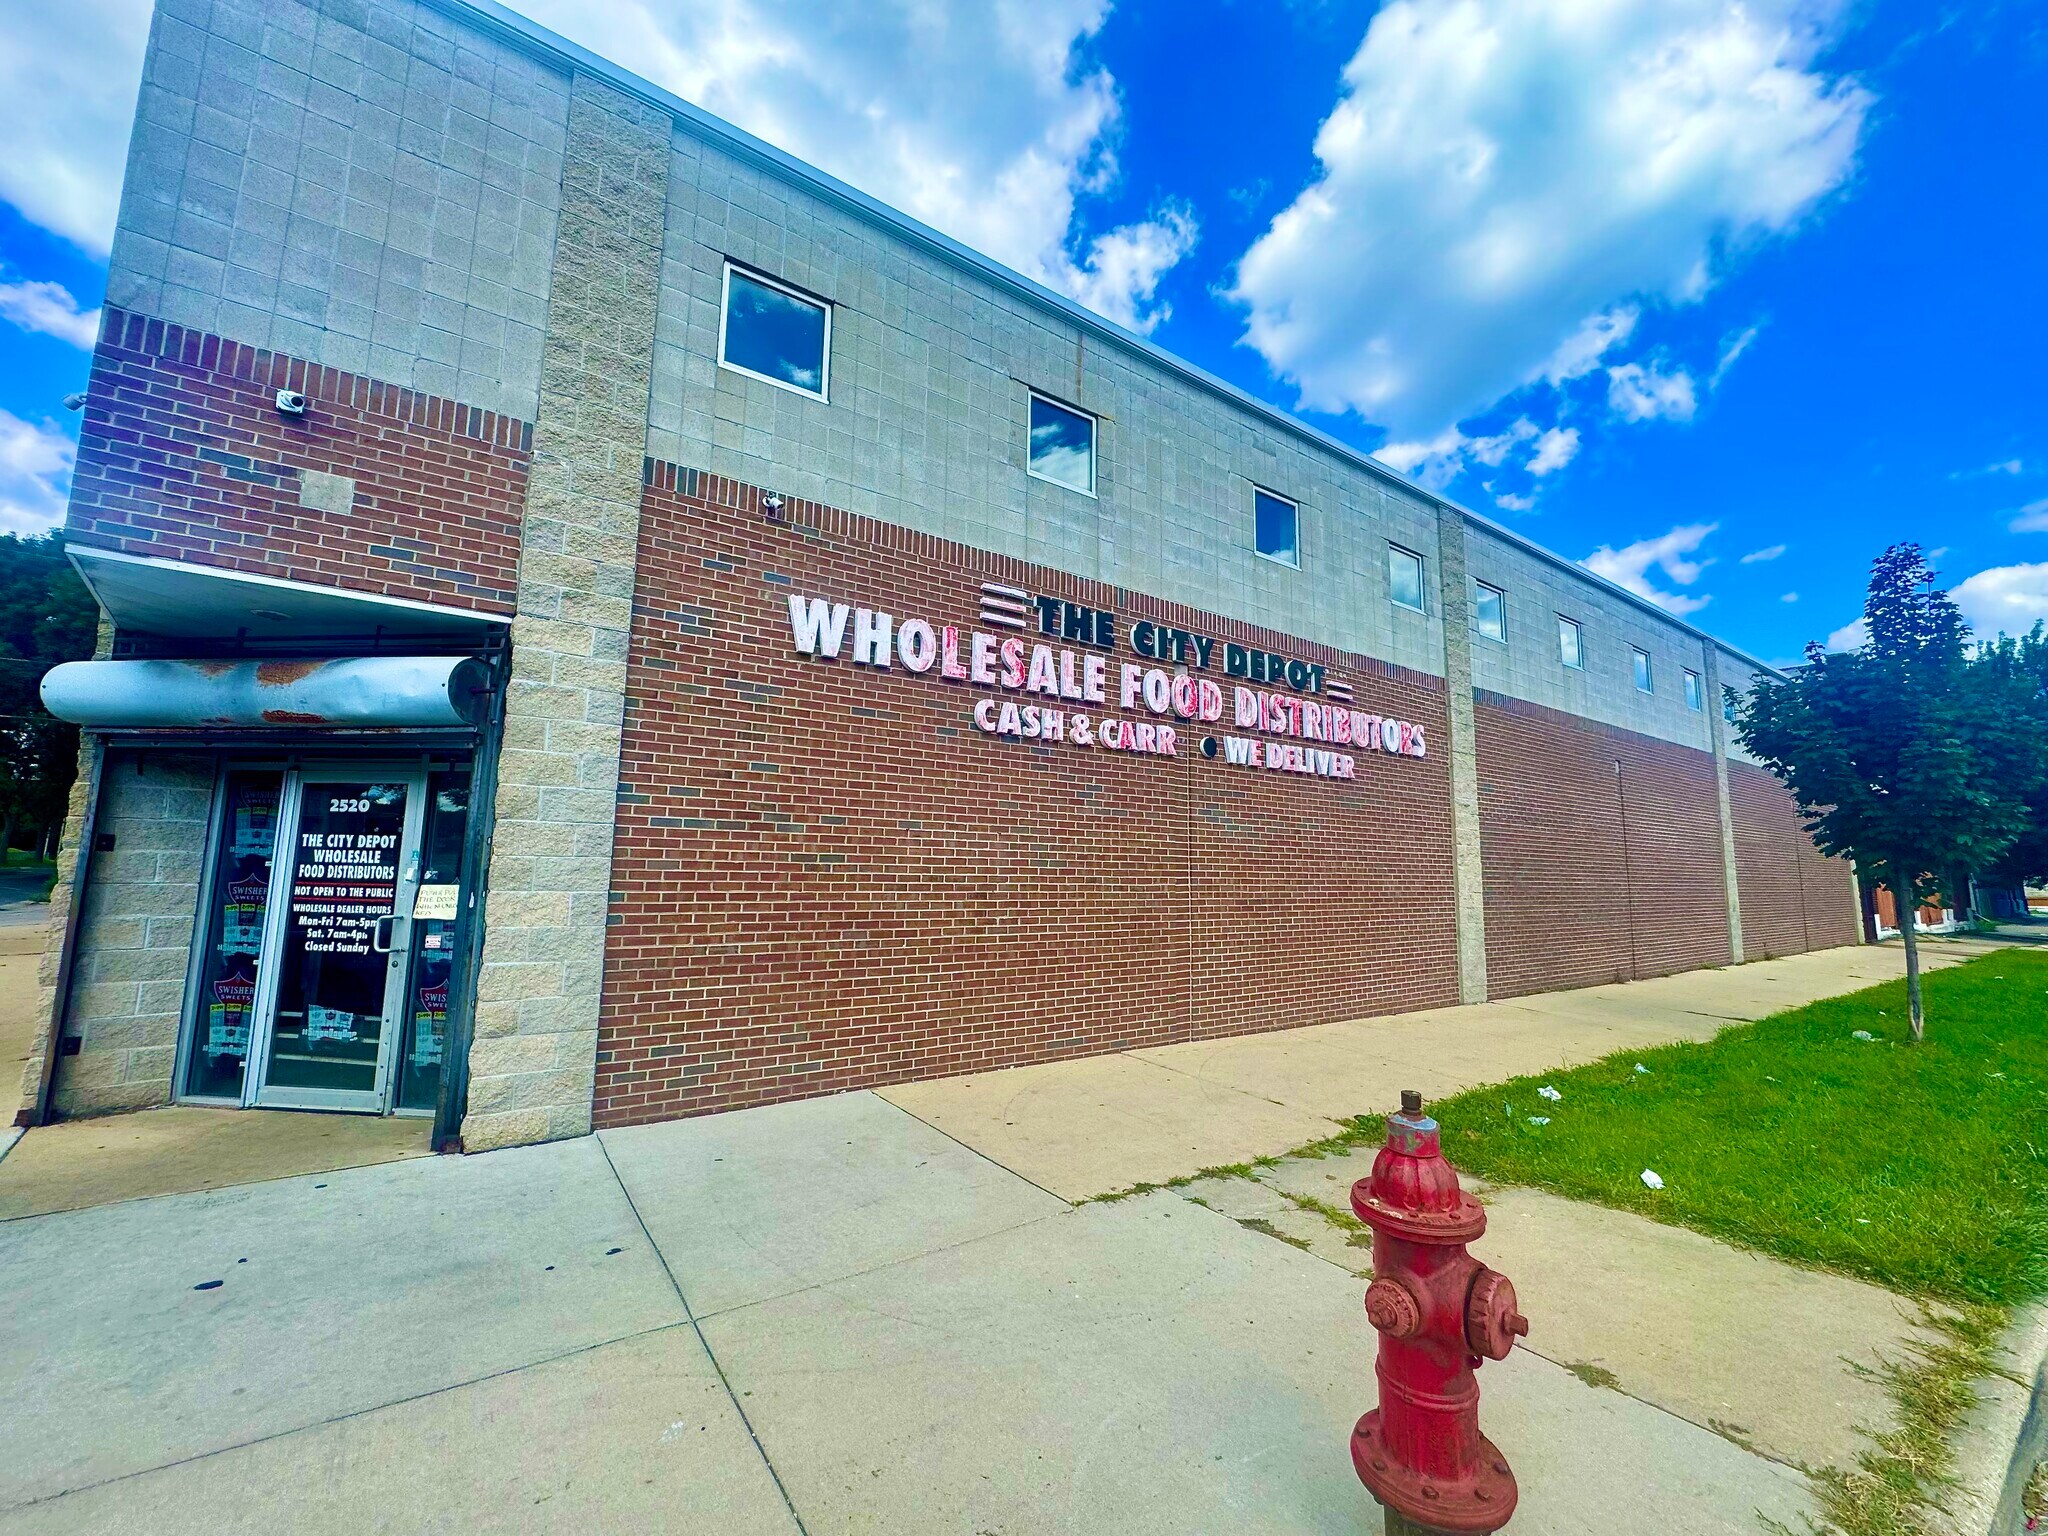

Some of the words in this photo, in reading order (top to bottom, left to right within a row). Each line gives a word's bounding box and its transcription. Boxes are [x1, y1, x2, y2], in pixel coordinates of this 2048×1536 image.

[1033, 595, 1116, 648] THE
[1130, 620, 1214, 669] CITY
[1224, 642, 1325, 693] DEPOT
[787, 594, 1106, 703] WHOLESALE
[1120, 662, 1224, 722] FOOD
[1234, 686, 1427, 758] DISTRIBUTORS
[974, 698, 1065, 742] CASH
[1068, 713, 1095, 747] &
[1098, 718, 1177, 756] CARR
[1224, 736, 1265, 768] WE
[1264, 743, 1356, 779] DELIVER
[330, 799, 370, 812] 2520
[302, 834, 323, 847] THE
[327, 834, 353, 848] CITY
[357, 835, 396, 848] DEPOT
[314, 850, 381, 864] WHOLESALE
[299, 866, 324, 878] FOOD
[327, 866, 394, 879] DISTRIBUTORS
[294, 886, 310, 896] NOT
[313, 887, 334, 896] OPEN
[336, 887, 347, 896] TO
[349, 888, 363, 897] THE
[365, 888, 393, 897] PUBLIC
[293, 904, 335, 913] WHOLESALE
[336, 905, 364, 914] DEALER
[366, 906, 391, 914] HOURS
[299, 916, 333, 926] Mon-Fri
[307, 929, 324, 938] Sat.
[305, 942, 334, 951] Closed
[336, 943, 369, 955] Sunday
[218, 986, 254, 994] SWISHER
